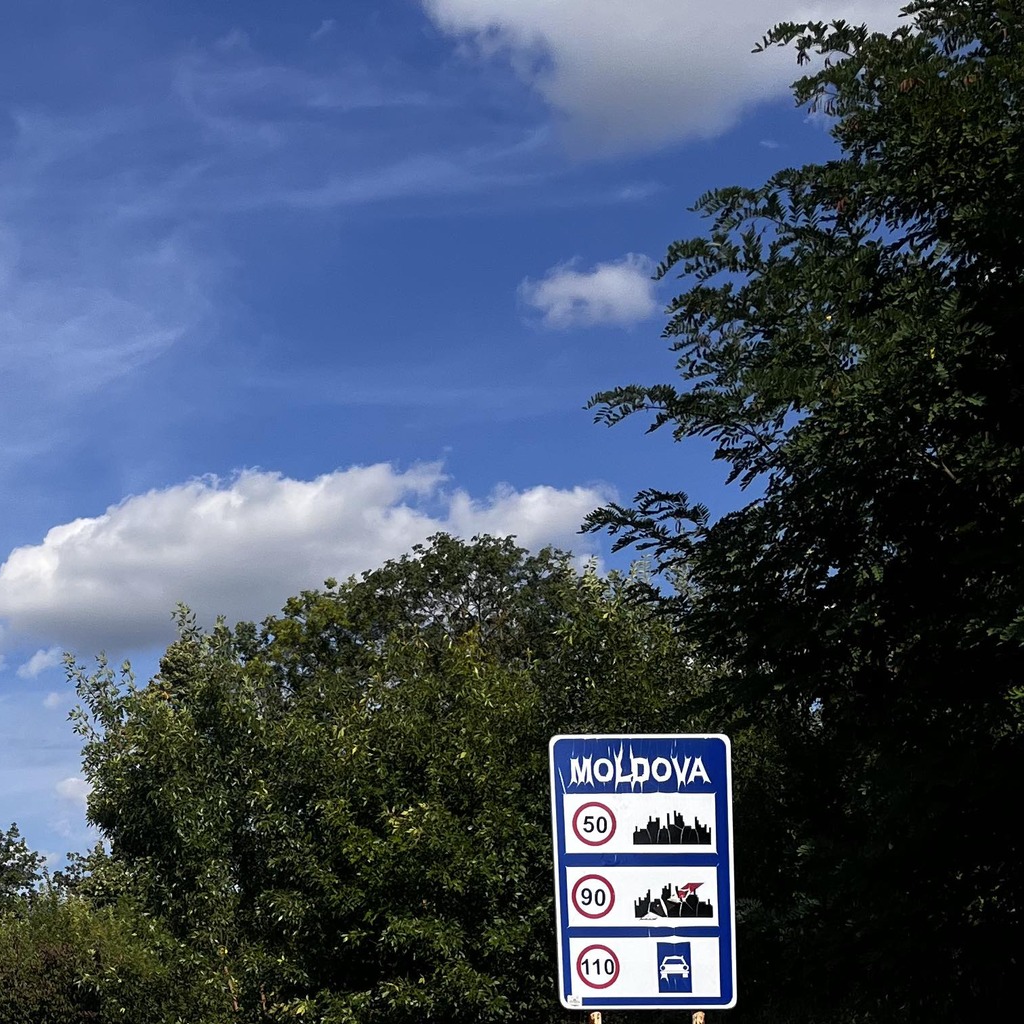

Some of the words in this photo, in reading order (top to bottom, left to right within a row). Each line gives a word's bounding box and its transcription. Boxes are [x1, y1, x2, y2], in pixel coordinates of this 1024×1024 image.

[568, 753, 712, 788] MOLDOVA
[582, 816, 608, 833] 50
[580, 888, 606, 906] 90
[581, 958, 615, 975] 110
